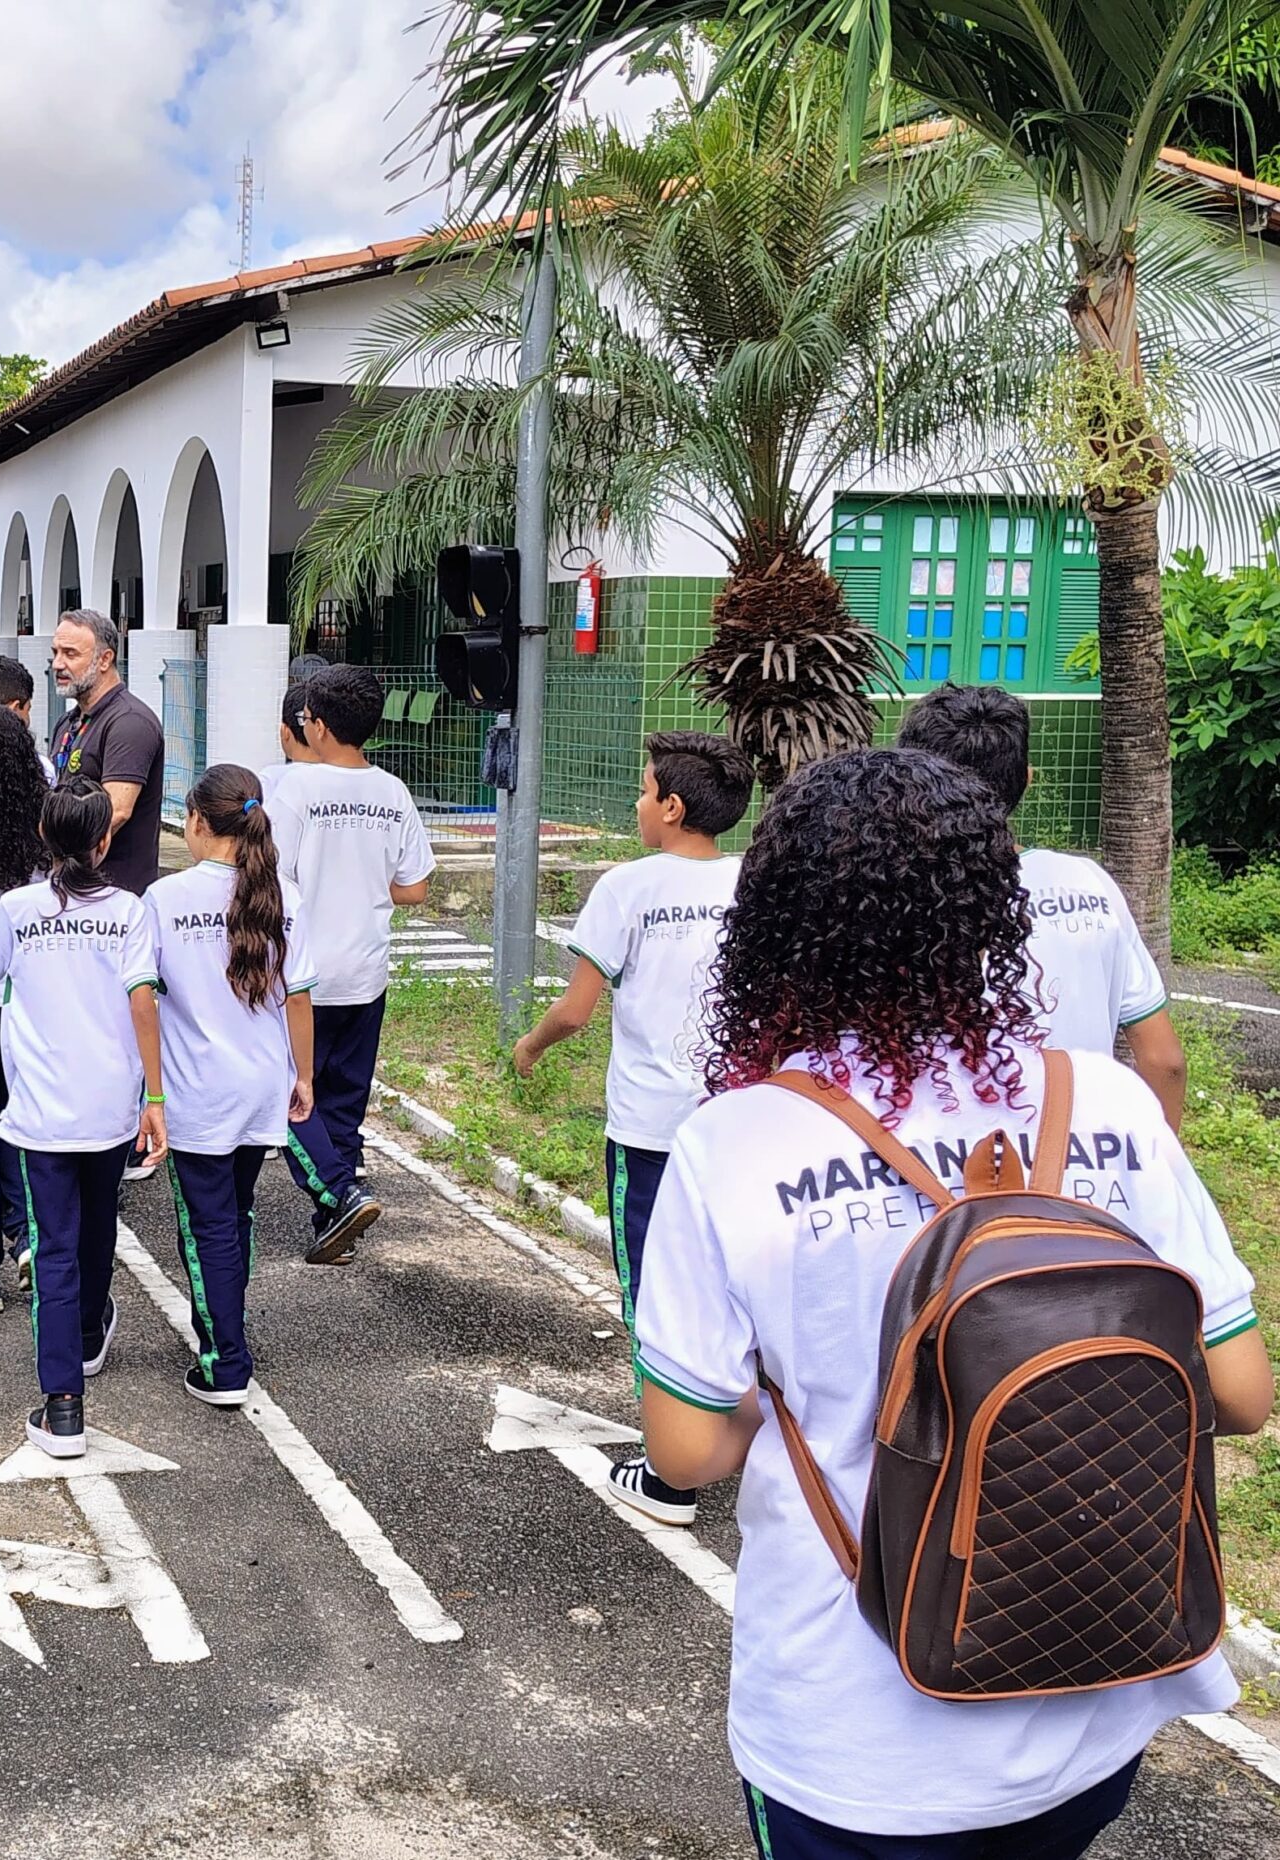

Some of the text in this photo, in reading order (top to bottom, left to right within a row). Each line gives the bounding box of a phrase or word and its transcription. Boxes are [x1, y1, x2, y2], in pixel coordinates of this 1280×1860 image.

[309, 803, 403, 823] MARANGUAPE
[15, 919, 128, 943] MARANGUAP
[23, 937, 121, 955] PREFEITUR
